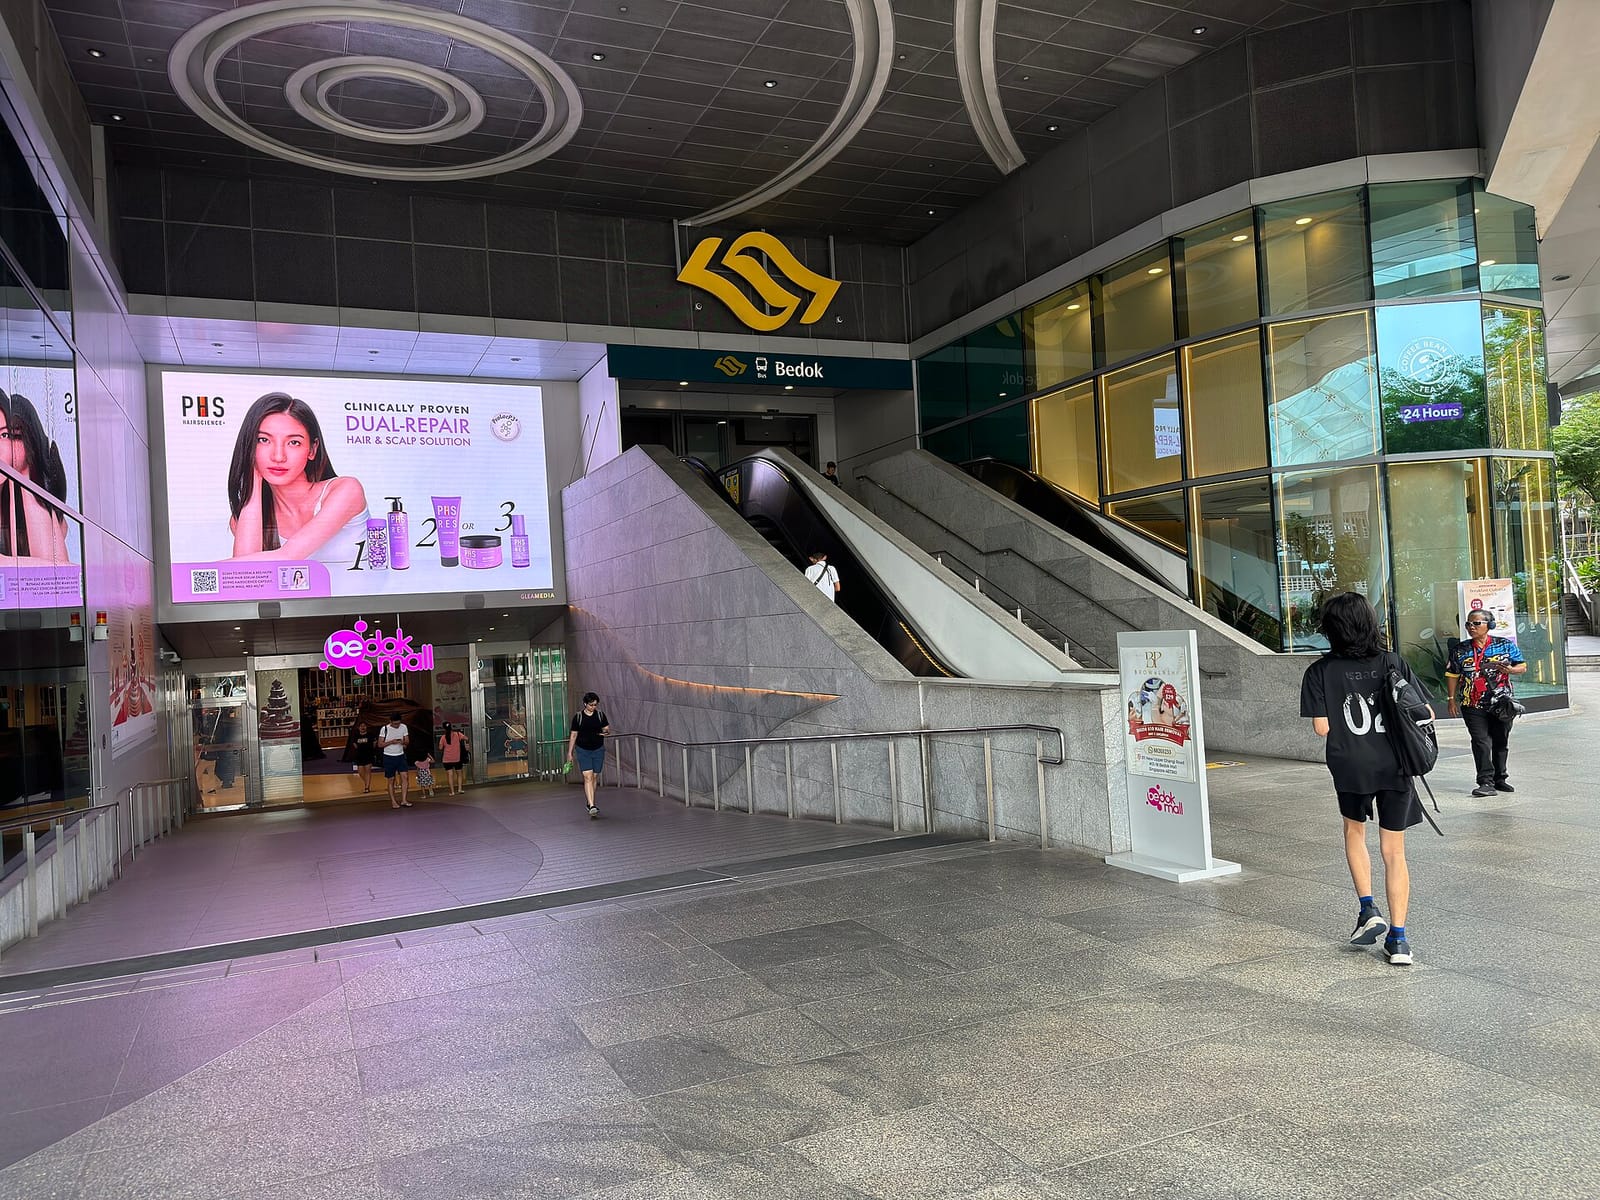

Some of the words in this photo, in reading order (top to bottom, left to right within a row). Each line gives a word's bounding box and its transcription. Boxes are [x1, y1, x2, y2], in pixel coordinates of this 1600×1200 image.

[1423, 341, 1447, 353] BEAN
[775, 361, 824, 378] Bedok
[182, 395, 225, 418] PHS
[344, 402, 414, 413] CLINICALLY
[420, 404, 469, 414] PROVEN
[1403, 408, 1420, 419] 24
[1422, 407, 1460, 418] Hours
[346, 415, 471, 434] DUAL-REPAIR
[346, 435, 371, 445] HAIR
[374, 436, 383, 445] &
[385, 436, 417, 445] SCALP
[420, 437, 471, 446] SOLUTION
[437, 505, 457, 516] PHS
[494, 501, 515, 531] 3
[438, 520, 458, 528] RES
[461, 522, 475, 530] OR
[415, 517, 437, 547] 2
[346, 540, 366, 571] 1
[326, 628, 414, 660] bedok
[376, 643, 435, 675] mall
[1147, 790, 1176, 805] bedok
[1164, 801, 1184, 815] mall
